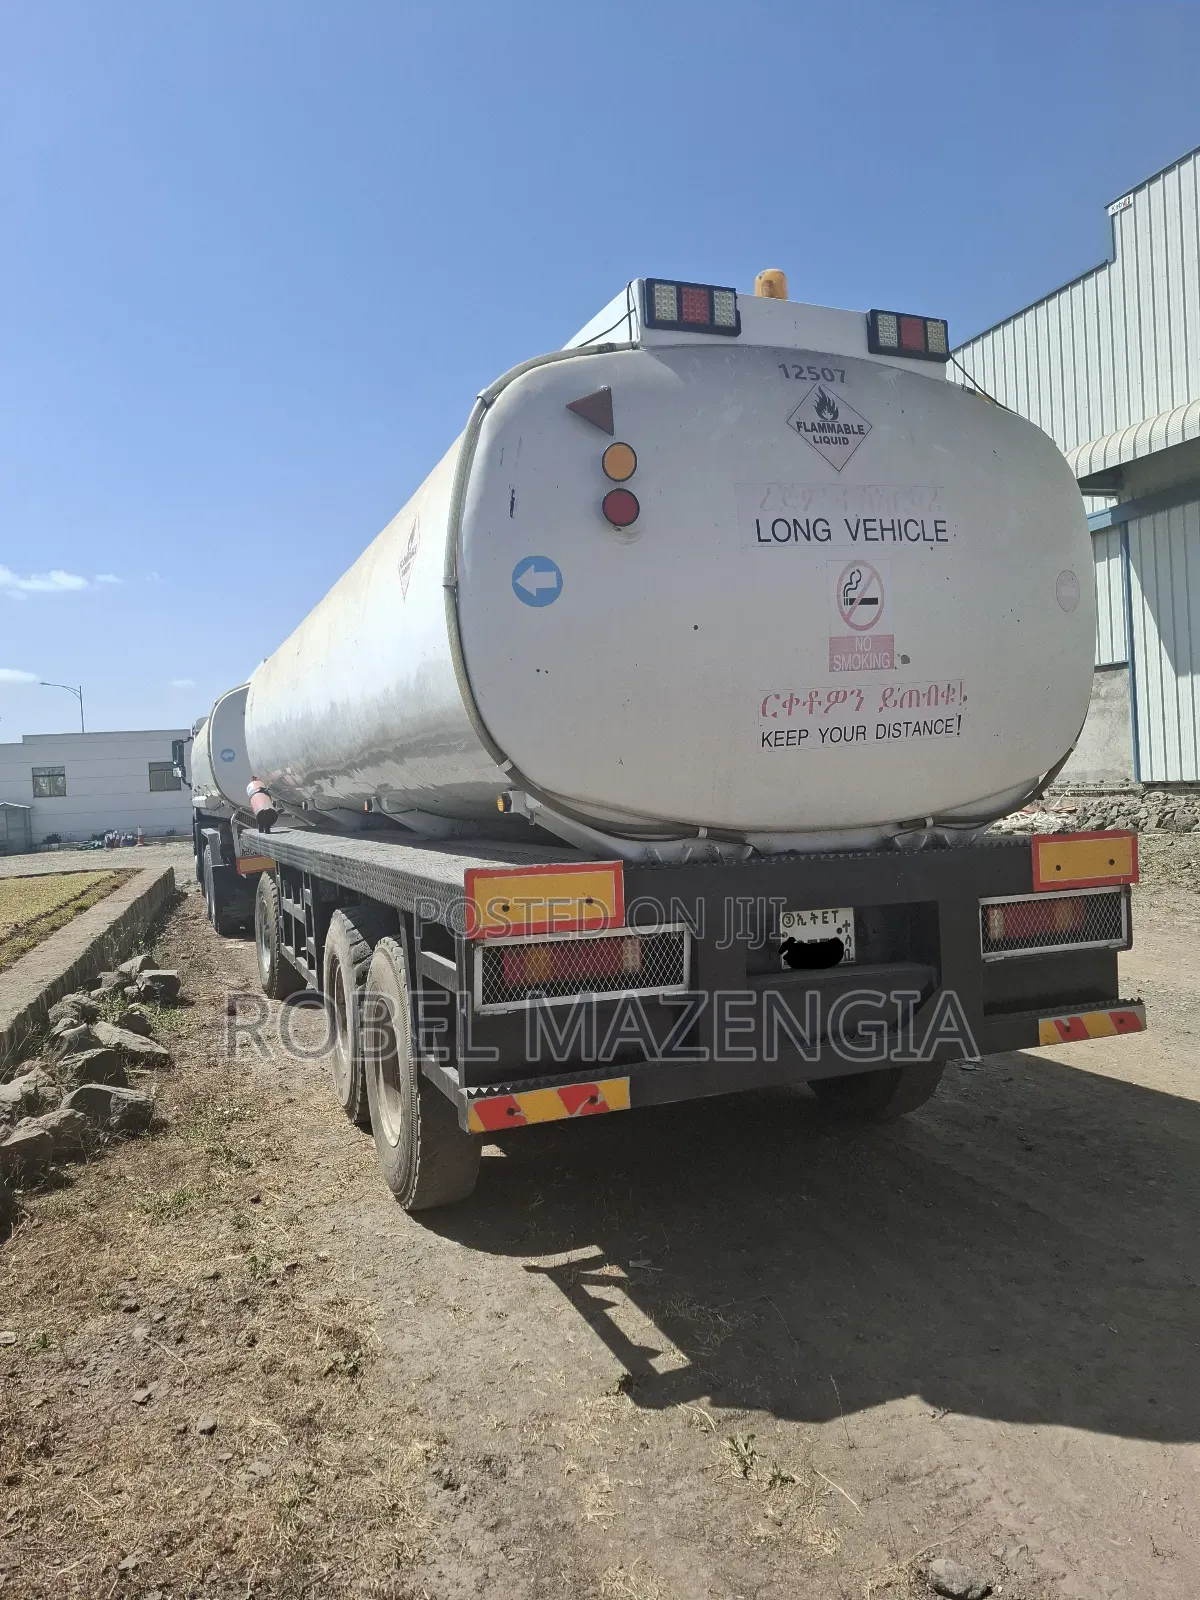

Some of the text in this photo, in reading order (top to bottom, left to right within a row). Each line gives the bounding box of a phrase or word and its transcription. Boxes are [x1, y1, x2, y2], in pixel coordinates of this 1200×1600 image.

[778, 363, 846, 384] 12507
[795, 421, 866, 436] FLAMMABLE
[812, 435, 850, 446] LIQUID
[755, 518, 949, 543] LONG VEHICLE
[854, 635, 872, 652] NO
[832, 652, 891, 672] SMOKING
[761, 714, 962, 748] KEEP YOUR DISTANCE!
[821, 909, 839, 925] ET
